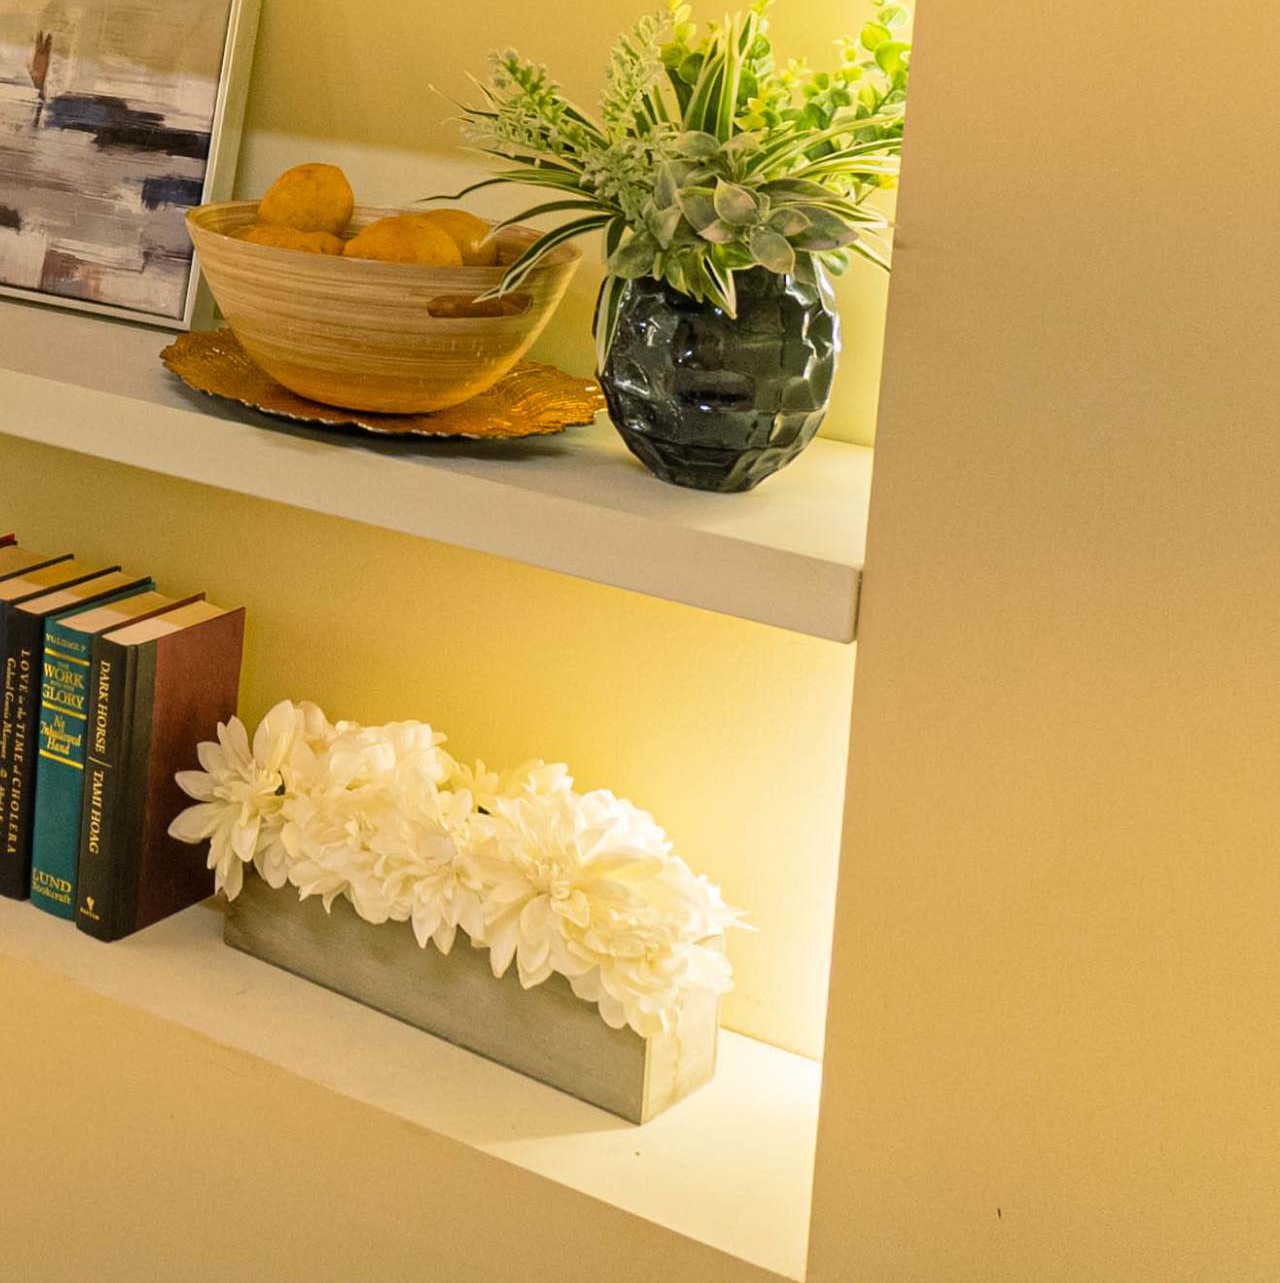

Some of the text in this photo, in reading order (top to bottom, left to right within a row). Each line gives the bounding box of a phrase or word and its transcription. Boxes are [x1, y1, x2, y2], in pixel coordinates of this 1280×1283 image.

[19, 649, 31, 693] LOVE
[43, 662, 85, 690] WORK
[42, 683, 85, 709] GLORY
[13, 721, 26, 763] TIME
[89, 660, 111, 854] DARK HORSE TAMI HOAG
[7, 776, 22, 853] CHOLERA
[32, 868, 72, 894] LUND
